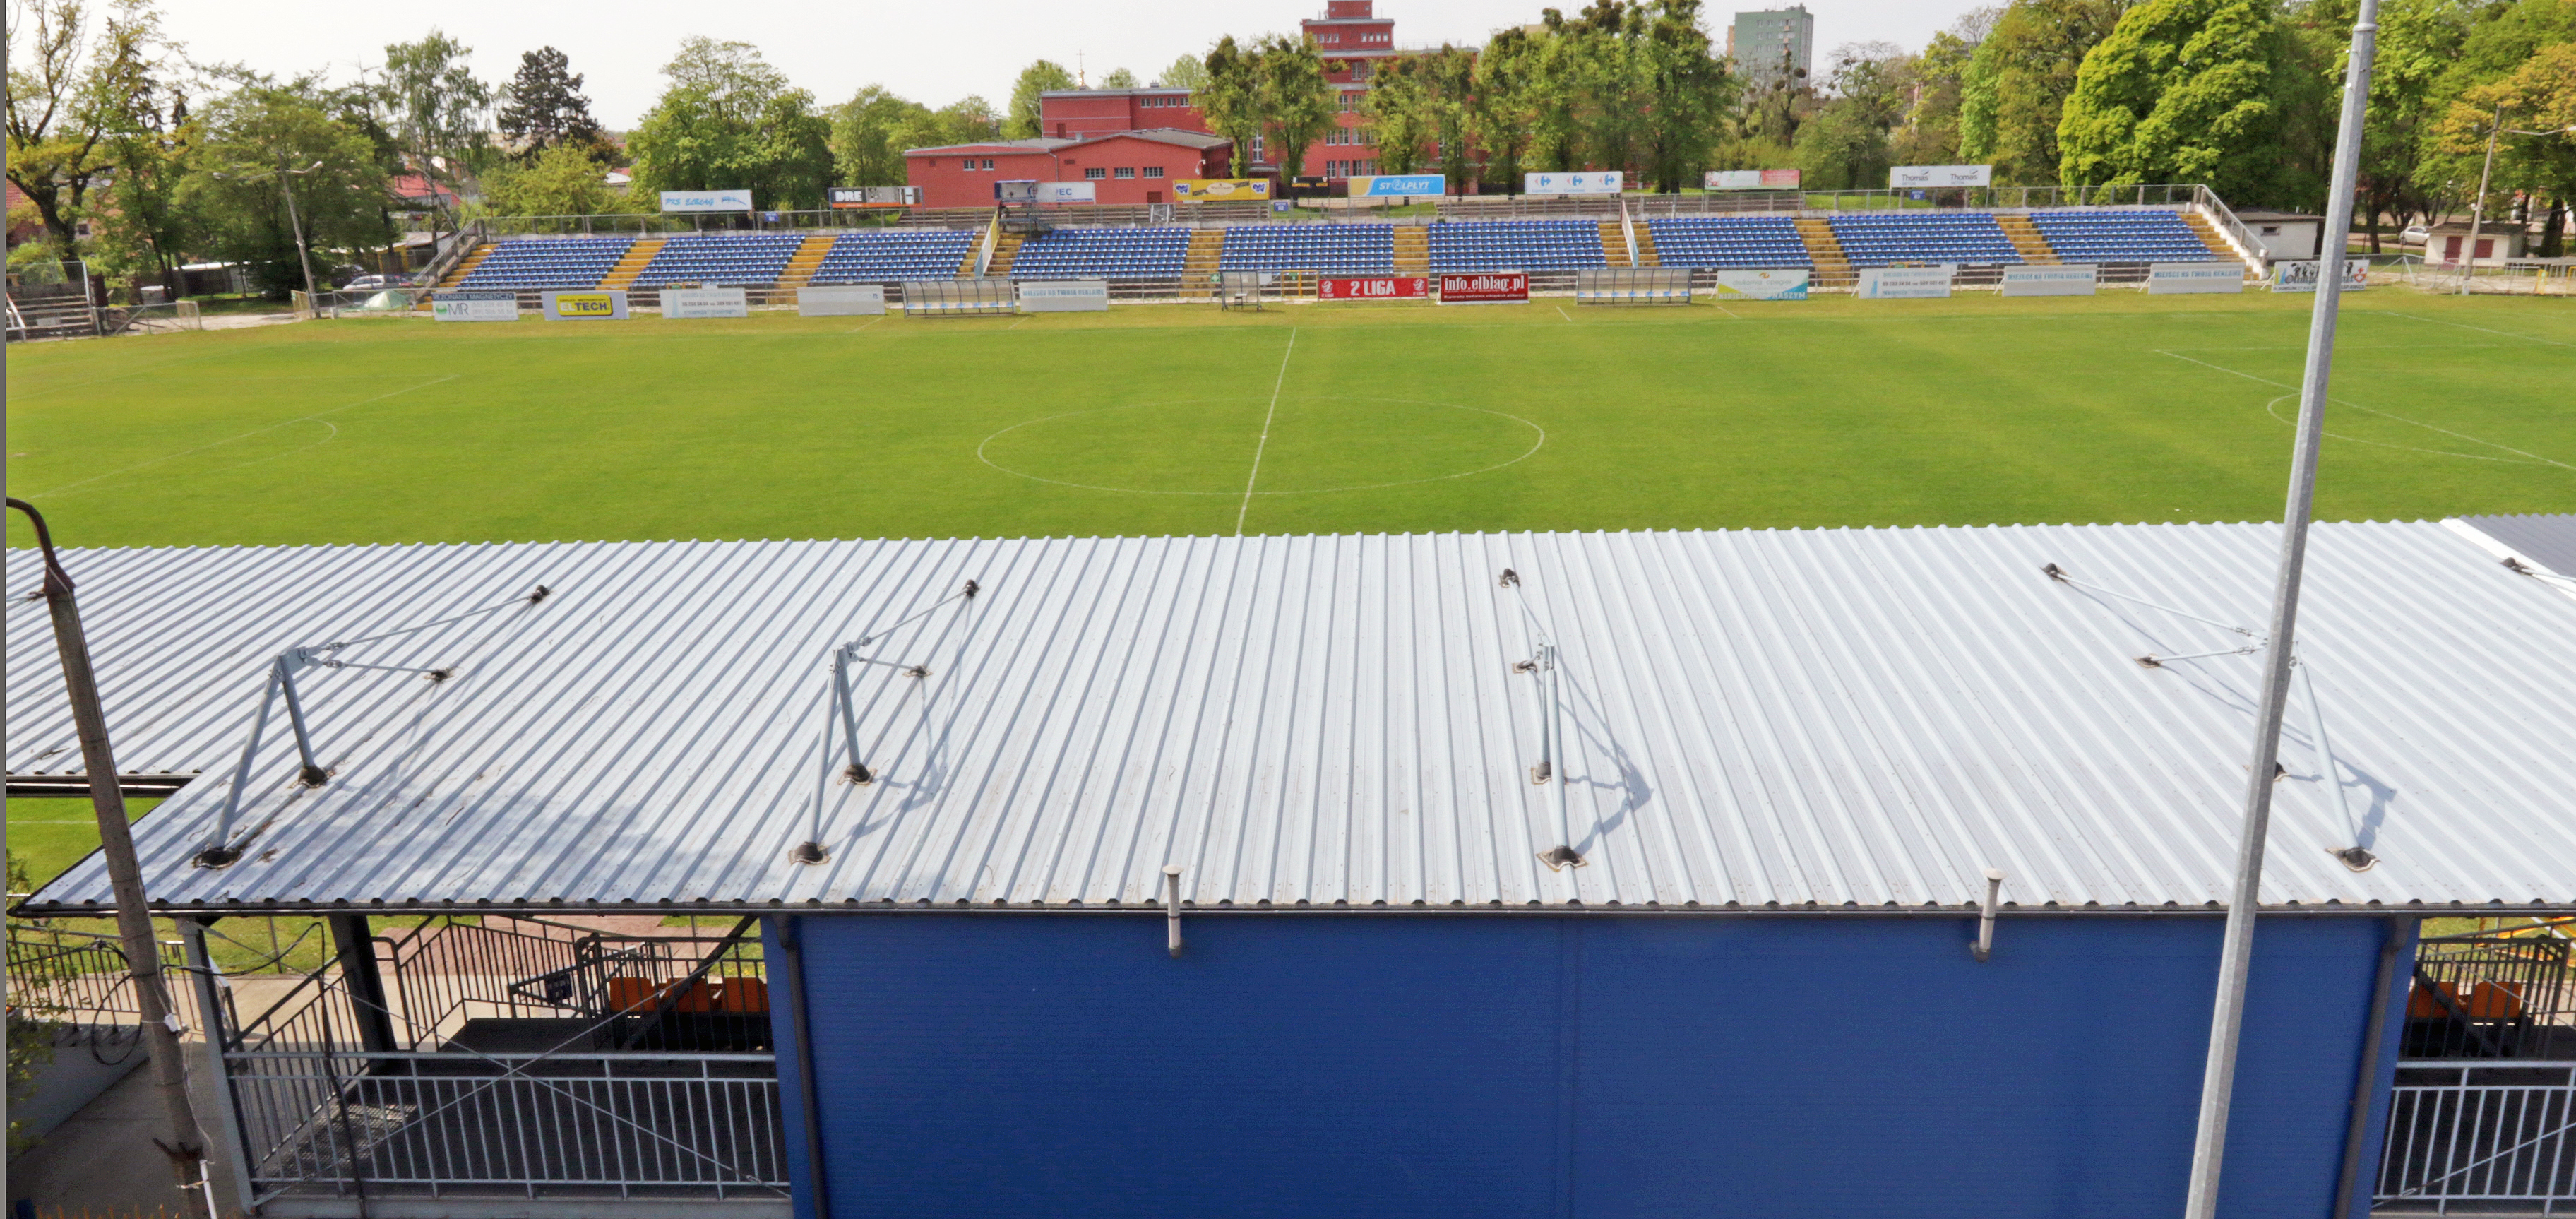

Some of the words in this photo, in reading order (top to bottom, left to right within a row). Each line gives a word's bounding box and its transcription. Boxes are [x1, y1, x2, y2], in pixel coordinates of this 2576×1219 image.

[835, 191, 862, 202] DRE
[1350, 281, 1360, 296] 2
[1364, 280, 1396, 295] LIGA
[1444, 275, 1525, 292] info.elblag.pl
[448, 303, 469, 316] MR
